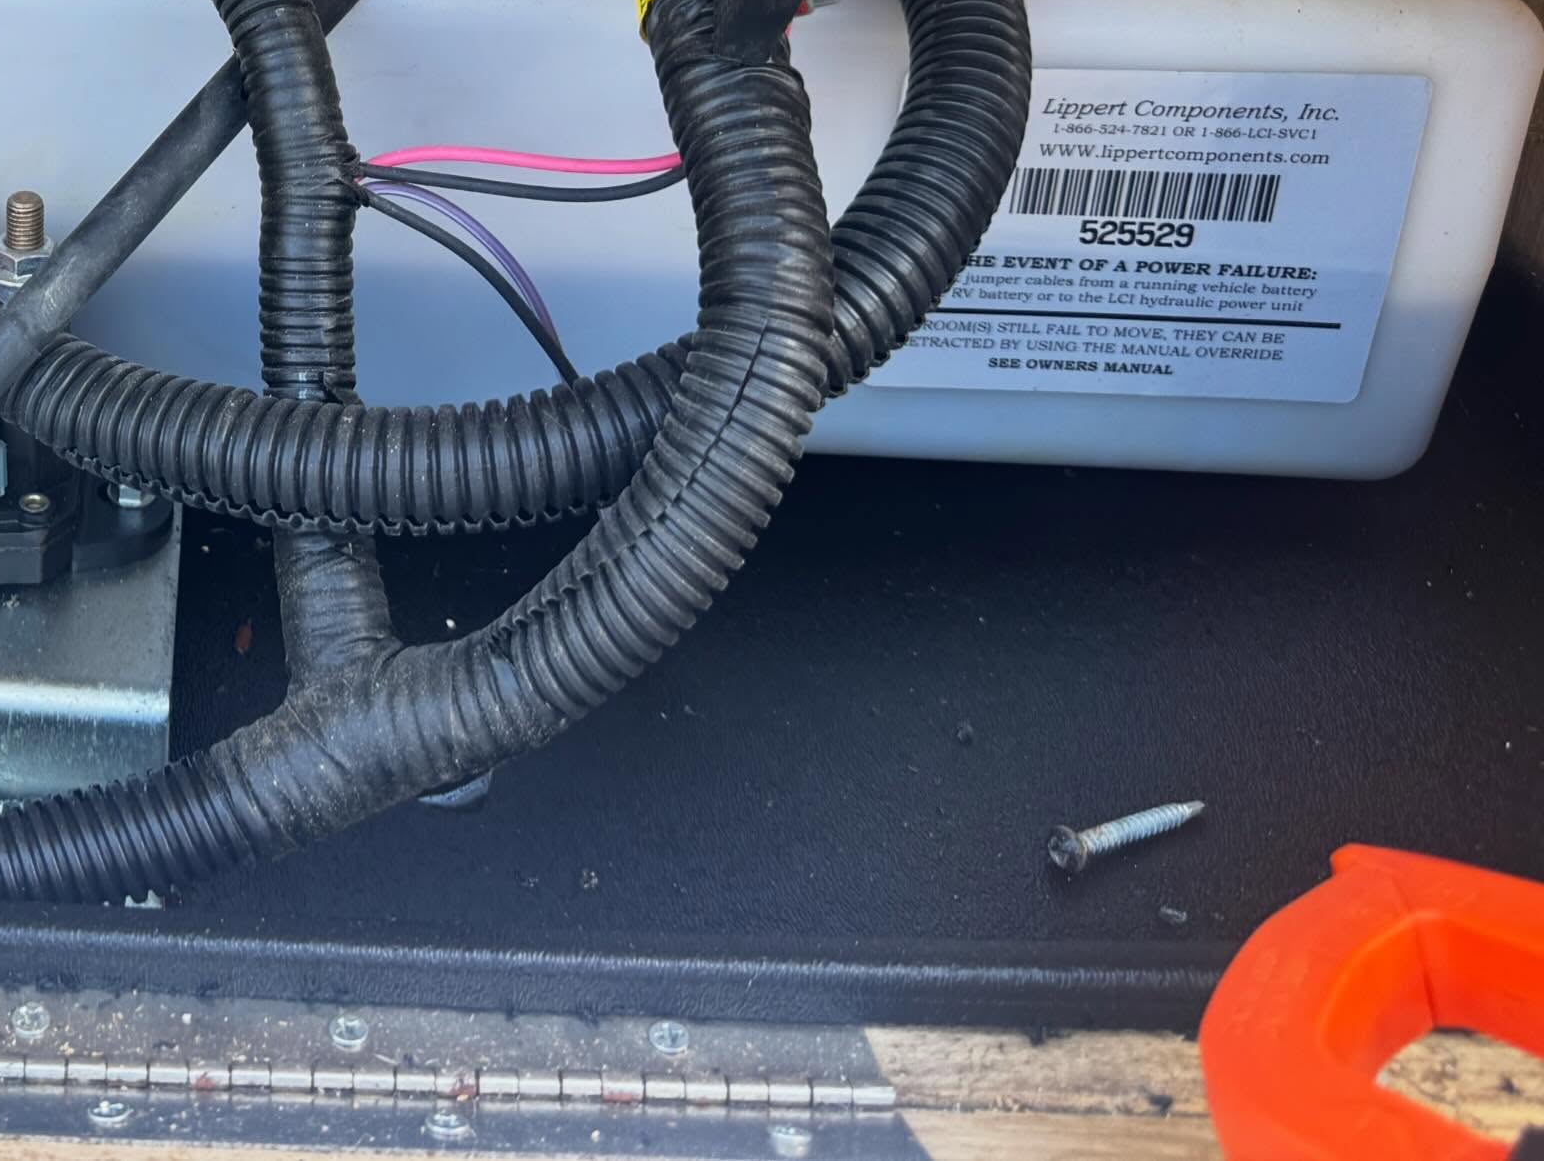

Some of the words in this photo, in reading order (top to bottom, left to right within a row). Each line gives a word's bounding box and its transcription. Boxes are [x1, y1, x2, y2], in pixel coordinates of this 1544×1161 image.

[1042, 98, 1127, 120] Lippert
[1135, 100, 1288, 122] Components,
[1297, 103, 1340, 121] Inc.
[1053, 123, 1168, 137] 1-866-524-7821
[1172, 125, 1195, 137] OR
[1201, 127, 1317, 140] 1-866-LCI-SVC1
[1079, 219, 1195, 248] 525529
[966, 255, 996, 268] HE
[1002, 256, 1073, 271] EVENT
[1078, 258, 1108, 272] OF
[1112, 259, 1129, 273] A
[1135, 260, 1211, 276] POWER
[1218, 264, 1318, 280] FAILURE:
[962, 273, 1020, 287] jumper
[1025, 274, 1073, 287] cables
[1079, 276, 1114, 288] from
[1119, 280, 1129, 289] a
[1133, 279, 1197, 294] running
[1202, 281, 1256, 295] vehicle
[1261, 283, 1318, 299] battery
[951, 287, 974, 300] RV
[978, 288, 1032, 303] battery
[1037, 292, 1054, 302] or
[1058, 290, 1074, 303] to
[1078, 290, 1103, 304] the
[1108, 292, 1136, 305] LCI
[1139, 294, 1213, 309] hydraulic
[1218, 299, 1266, 312] power
[1271, 300, 1304, 312] unit
[997, 322, 1041, 335] STILL
[1046, 323, 1081, 336] FAIL
[1086, 324, 1108, 337] TO
[1113, 326, 1167, 341] MOVE,
[1173, 328, 1218, 342] THEY
[1222, 330, 1257, 343] CAN
[1261, 332, 1285, 345] BE
[907, 336, 995, 349] ETRACTED
[999, 339, 1022, 351] BY
[1026, 340, 1078, 353] USING
[1082, 341, 1116, 355] THE
[1121, 343, 1191, 358] MANUAL
[1195, 346, 1284, 361] OVERRIDE
[988, 357, 1021, 370] SEE
[1026, 358, 1098, 372] OWNERS
[1103, 361, 1174, 376] MANUAL
